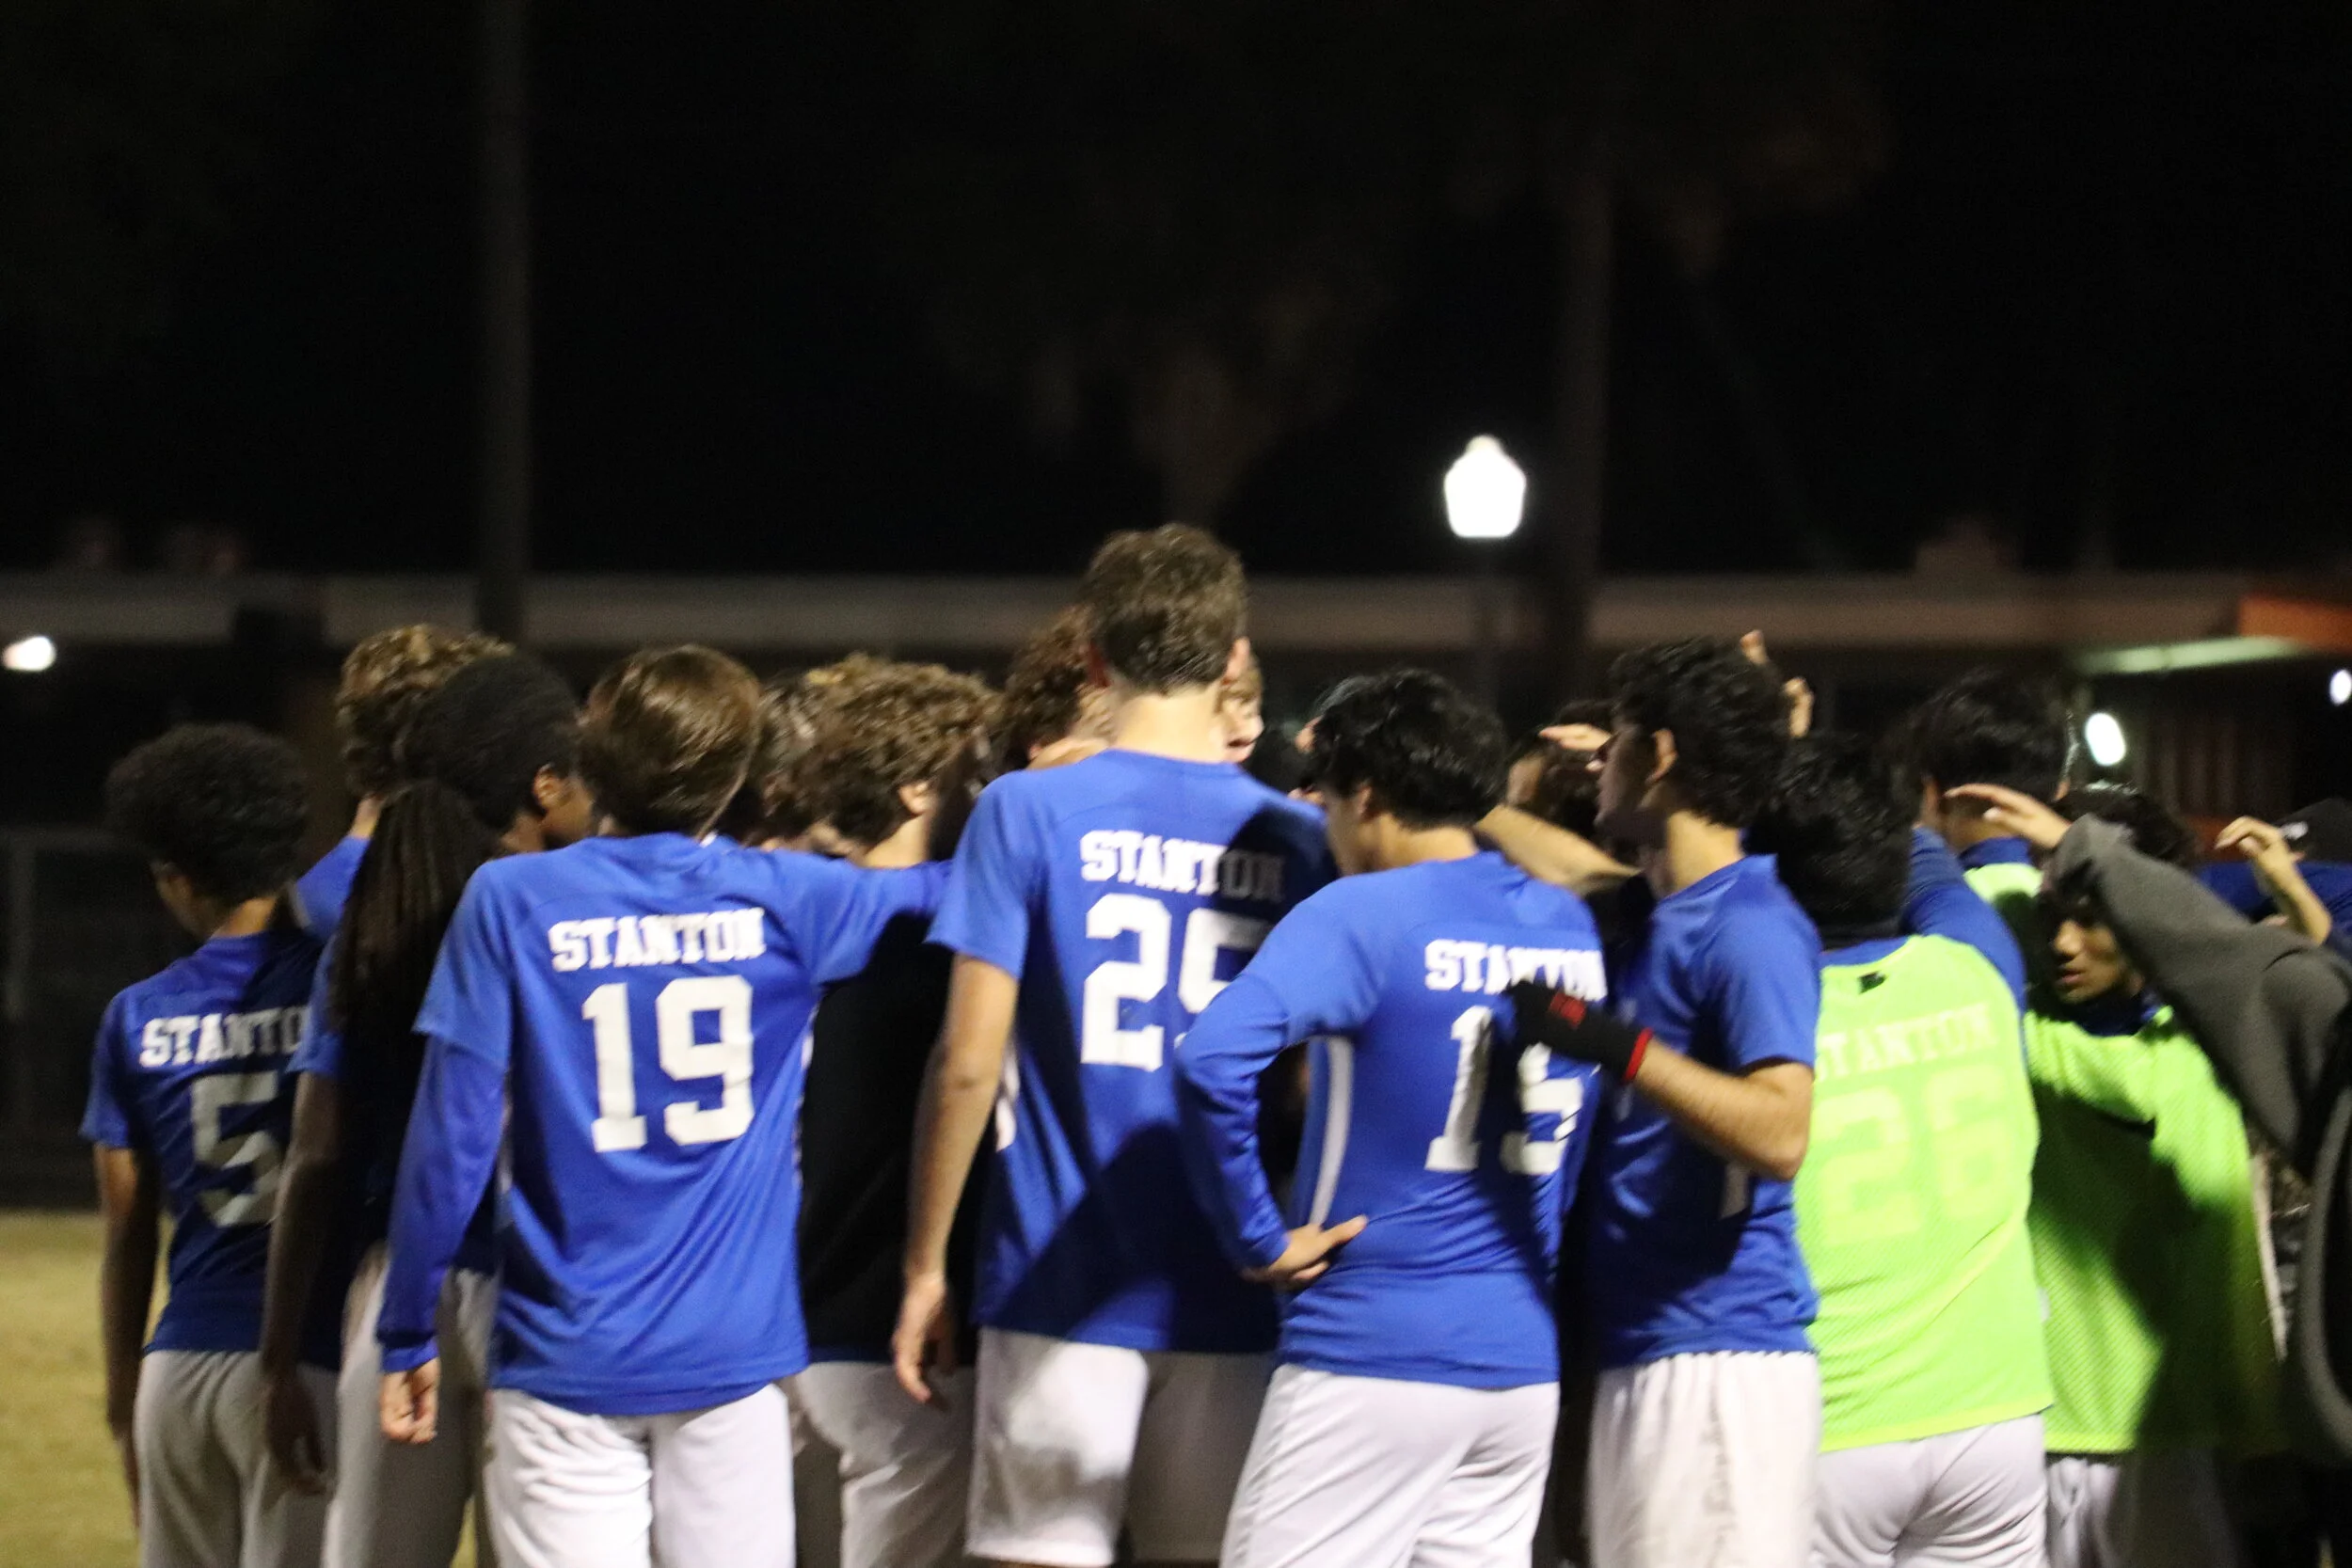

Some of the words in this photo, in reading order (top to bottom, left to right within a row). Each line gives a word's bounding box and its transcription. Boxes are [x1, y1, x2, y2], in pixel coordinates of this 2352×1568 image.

[1080, 830, 1285, 901] STANTON
[547, 908, 766, 972] STANTON
[581, 974, 755, 1153] 19
[190, 1069, 288, 1228] 5
